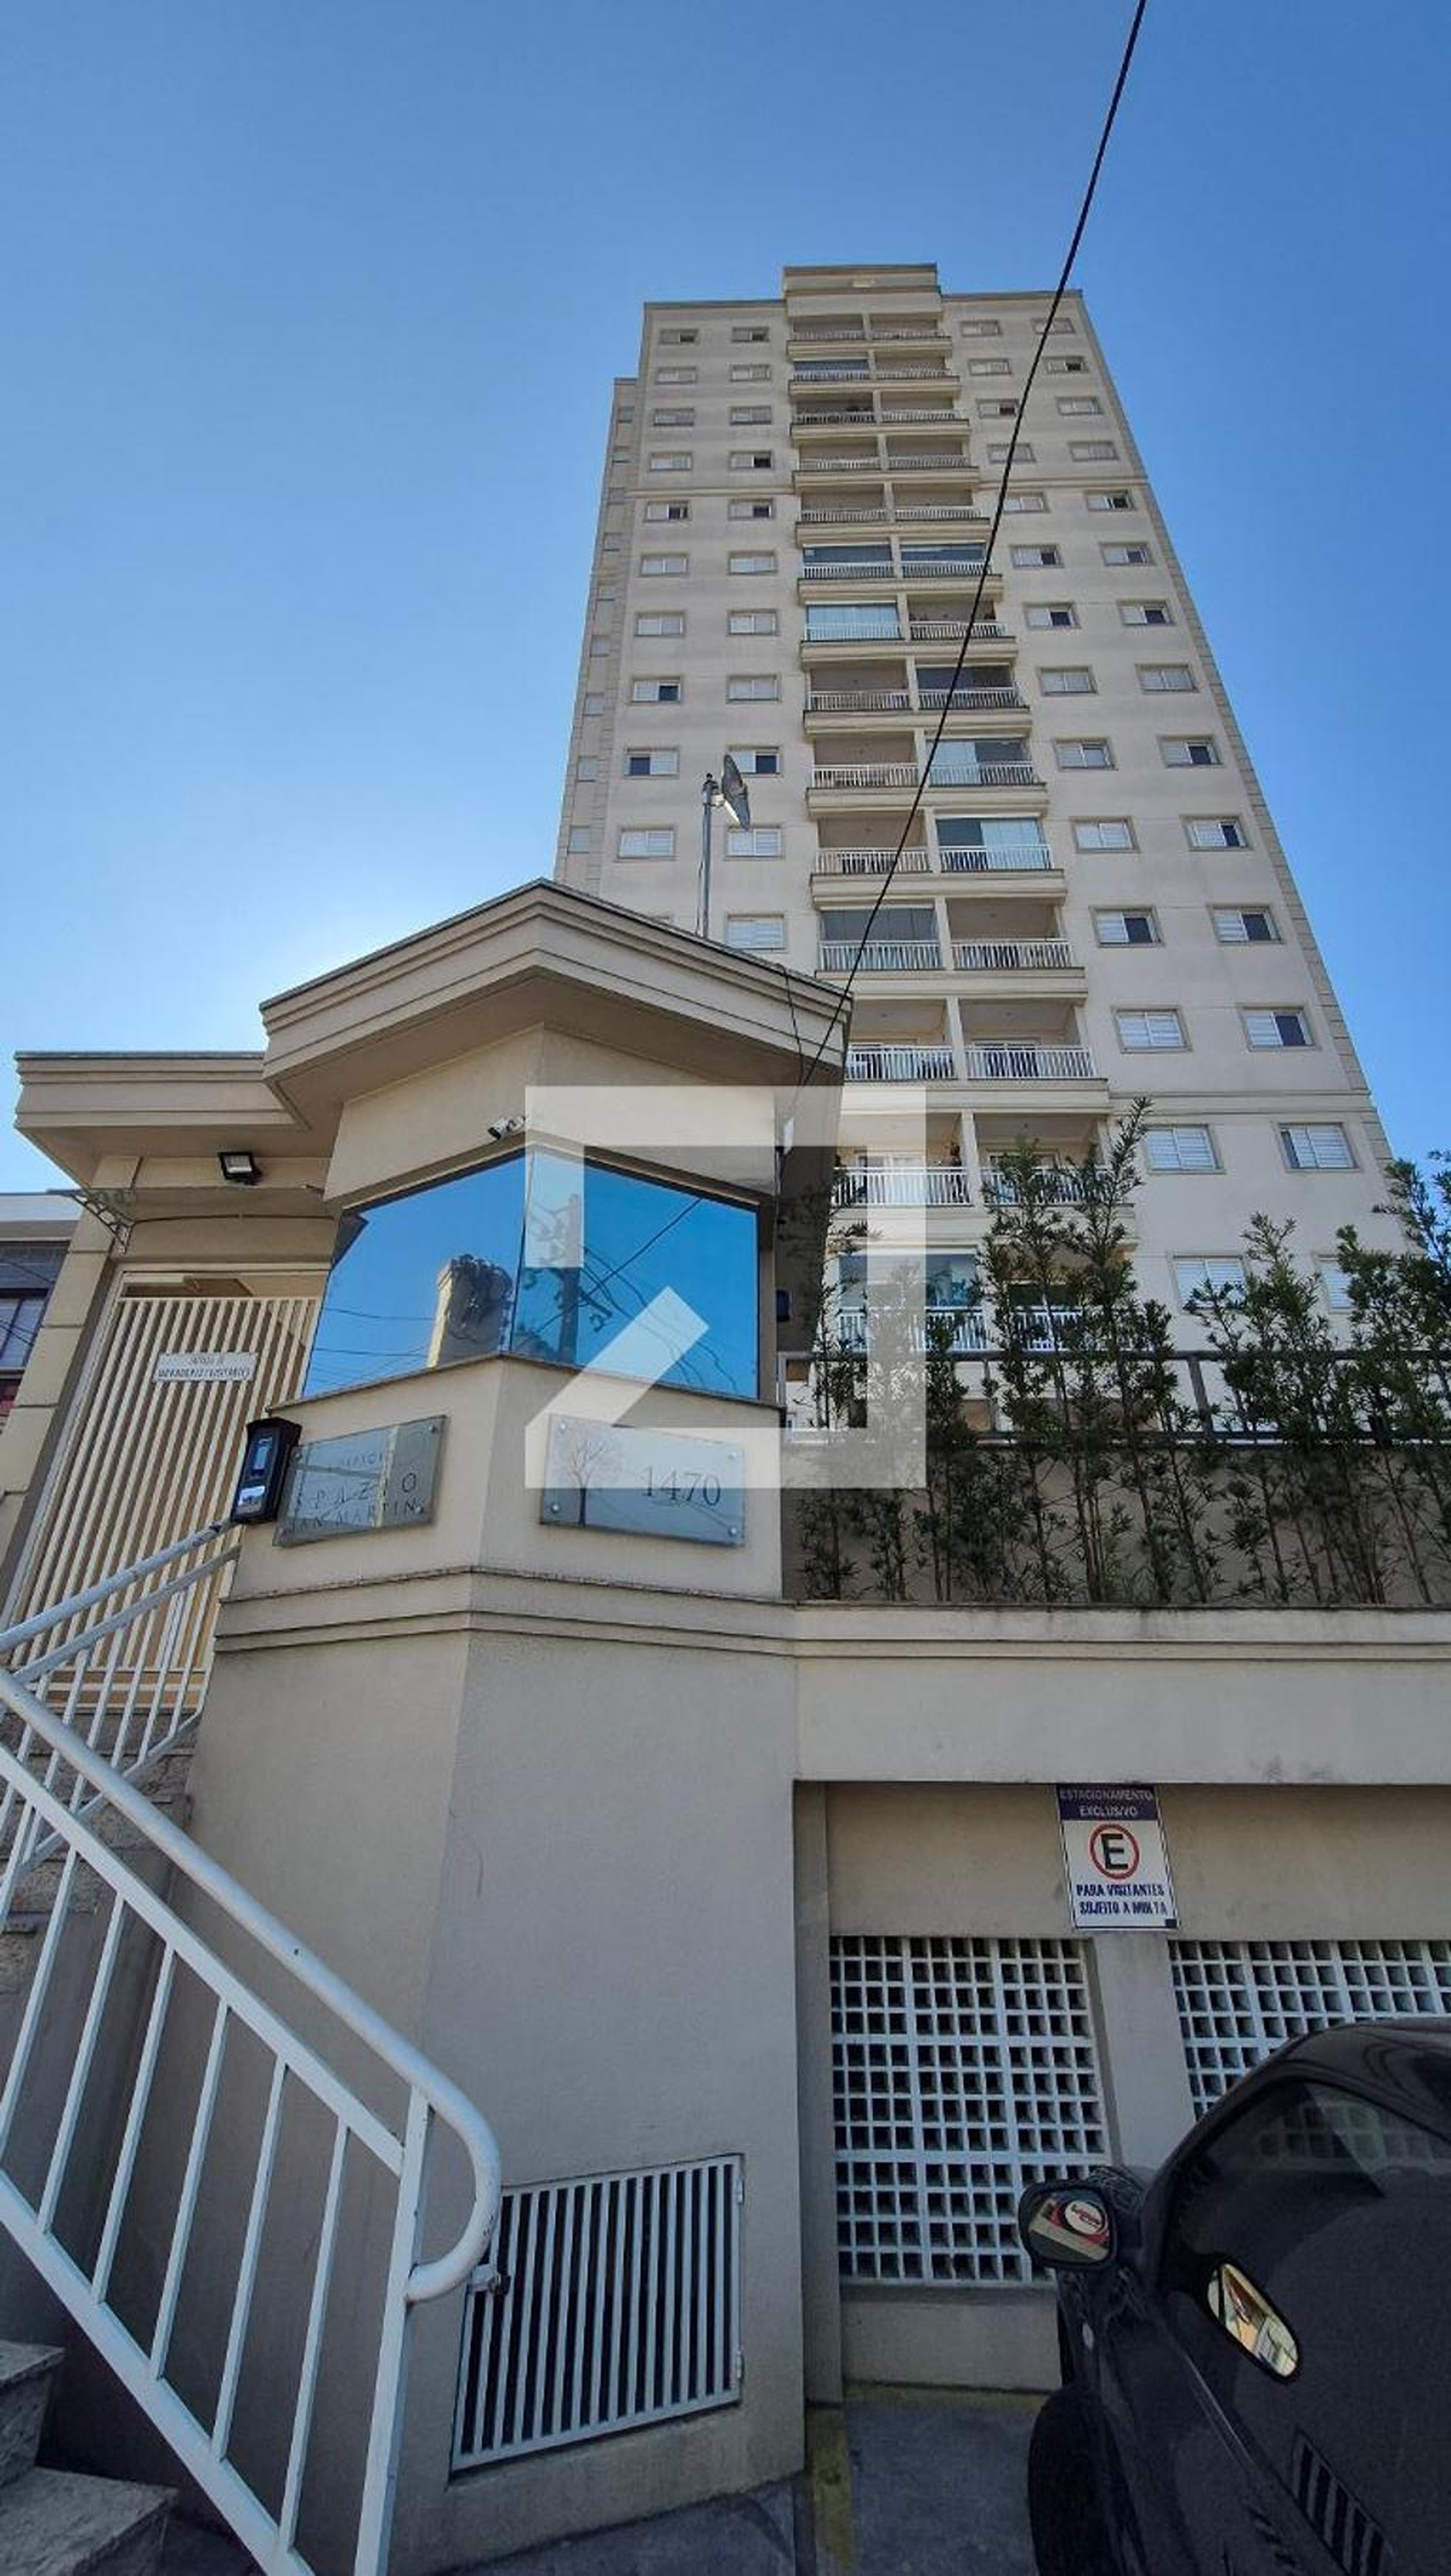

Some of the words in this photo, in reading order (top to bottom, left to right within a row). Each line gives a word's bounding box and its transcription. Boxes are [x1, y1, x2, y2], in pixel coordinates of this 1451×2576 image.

[642, 1466, 721, 1506] 1470
[1059, 1789, 1154, 1801] ESTACIONAMENTO
[1080, 1805, 1139, 1817] EXCLUSIVO
[1101, 1833, 1128, 1870] E
[1076, 1884, 1105, 1897] PARA
[1106, 1884, 1165, 1897] VISITANTES
[1080, 1901, 1119, 1914] SUJEITO
[1123, 1901, 1130, 1914] A
[1132, 1901, 1168, 1916] MULTA
